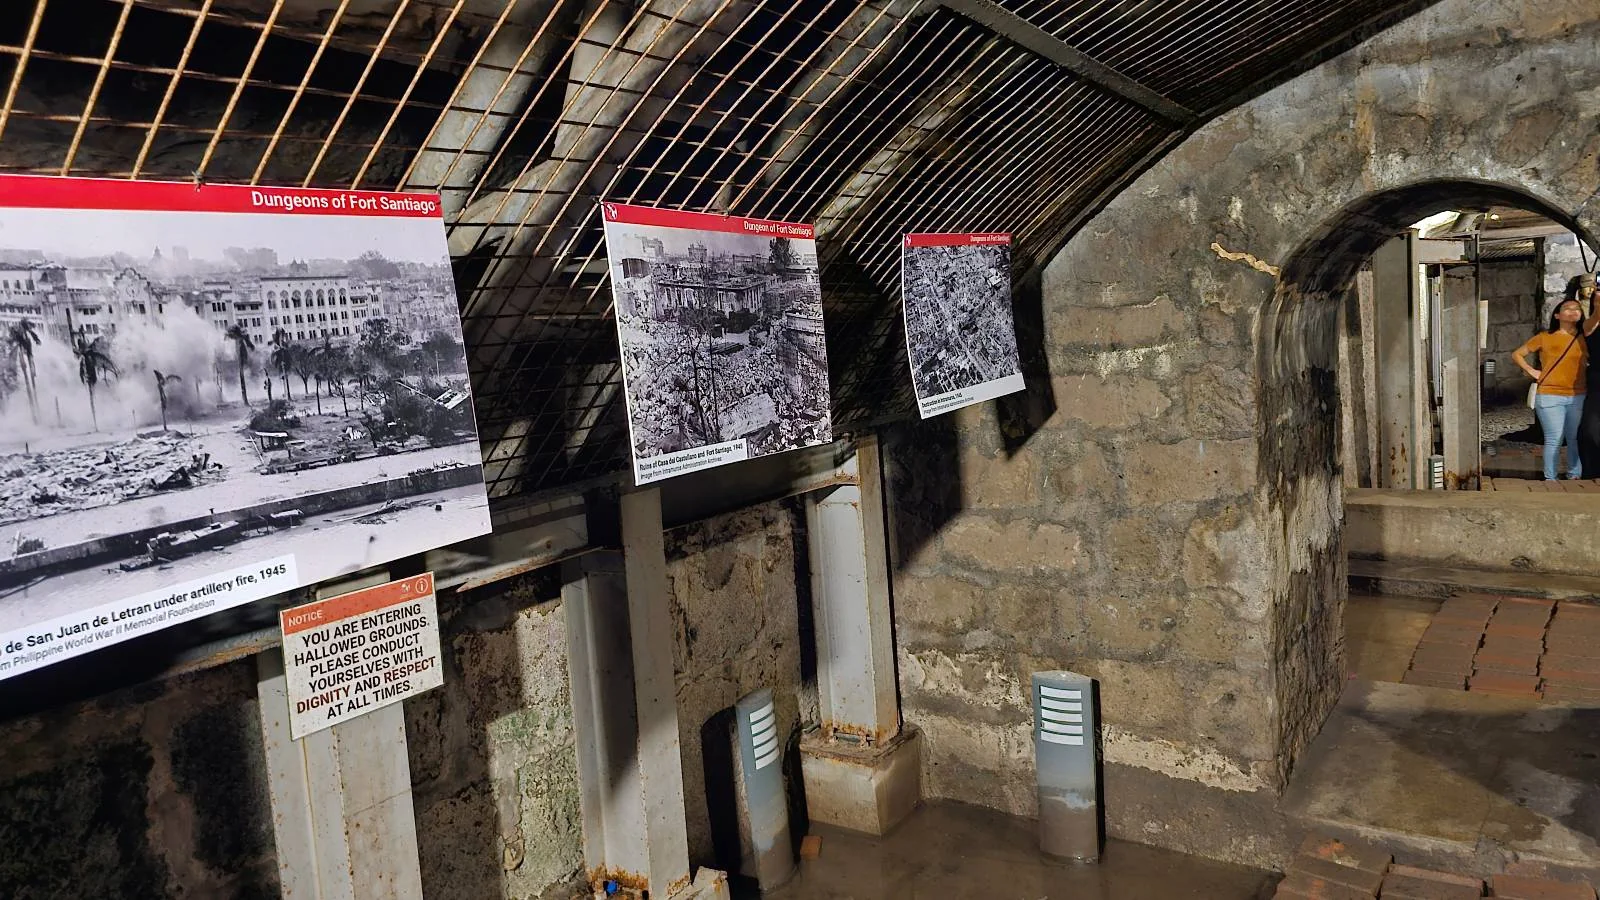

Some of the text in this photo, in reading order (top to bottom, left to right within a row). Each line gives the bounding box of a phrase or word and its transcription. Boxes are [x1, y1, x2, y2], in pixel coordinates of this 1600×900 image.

[252, 191, 436, 214] Dungeons of Fort Santiago
[744, 220, 812, 236] Dungeon of Fort Santiago
[6, 564, 287, 654] de San Juan de Letran under artillery fire, 1945
[288, 610, 322, 627] NOTICE
[302, 604, 421, 647] YOU ARE ENTERING
[13, 644, 64, 667] Philippine
[64, 634, 93, 650] World
[94, 628, 113, 640] War
[123, 612, 166, 632] Memorial
[167, 600, 215, 619] Foundation
[294, 616, 430, 666] HALLOWED GROUNDS.
[310, 633, 420, 677] PLEASE CONDUCT
[297, 656, 436, 714] DIGNITY AND RESPECT
[308, 646, 423, 693] YOURSELVES WITH
[327, 680, 414, 719] AT ALL TIMES.
